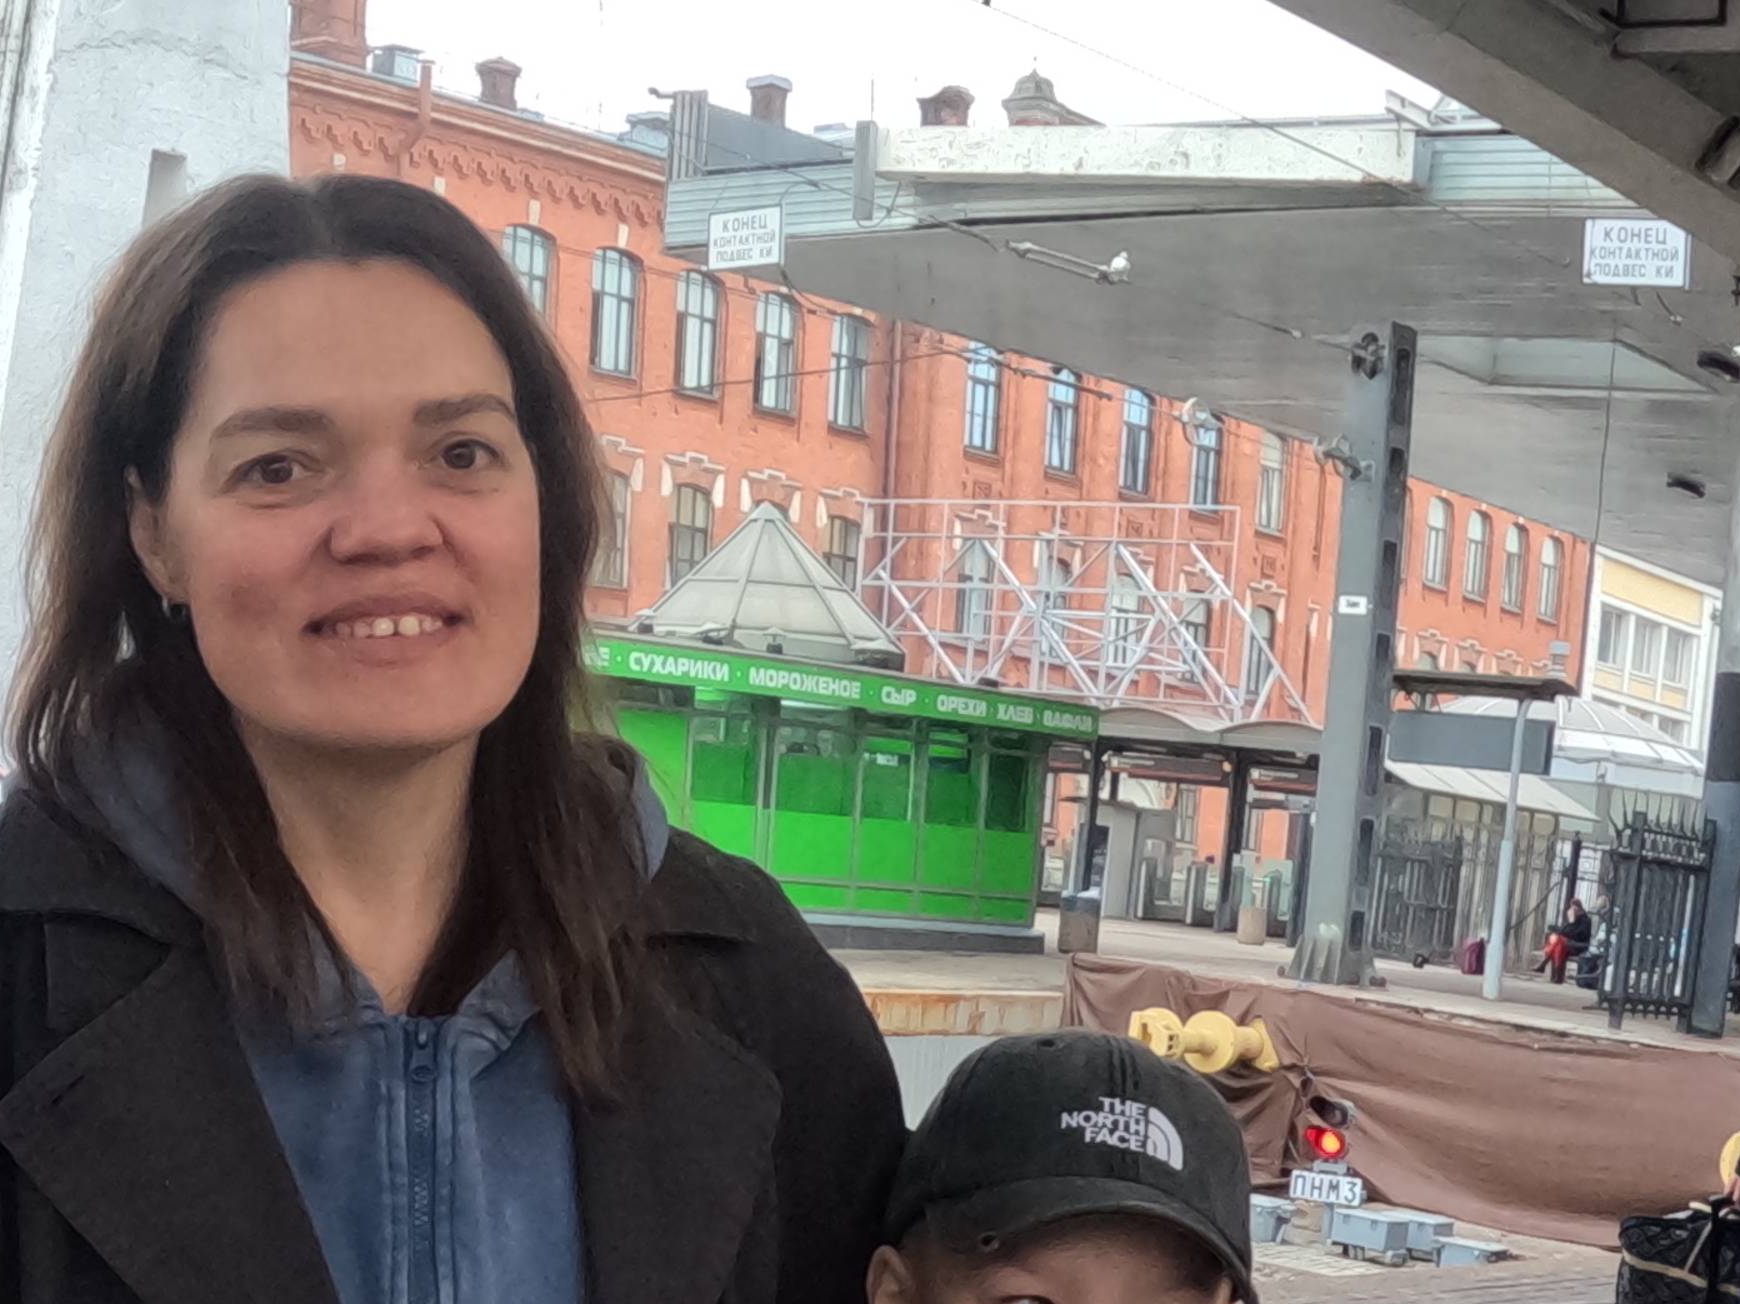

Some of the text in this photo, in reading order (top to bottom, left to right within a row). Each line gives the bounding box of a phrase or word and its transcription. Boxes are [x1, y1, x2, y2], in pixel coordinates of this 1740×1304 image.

[722, 214, 768, 233] КОНЕЦ
[1603, 226, 1667, 245] КОНЕЦ
[1591, 246, 1680, 262] КОНТАКТНОЙ
[629, 651, 729, 682] СУХАРИКИ
[749, 666, 861, 699] МОРОЖЕНОЕ
[881, 686, 917, 707] СЫР
[937, 694, 987, 717] ОРЕХИ
[1098, 1096, 1147, 1120] THE
[1061, 1110, 1146, 1137] NORTH
[1084, 1127, 1145, 1152] FACE
